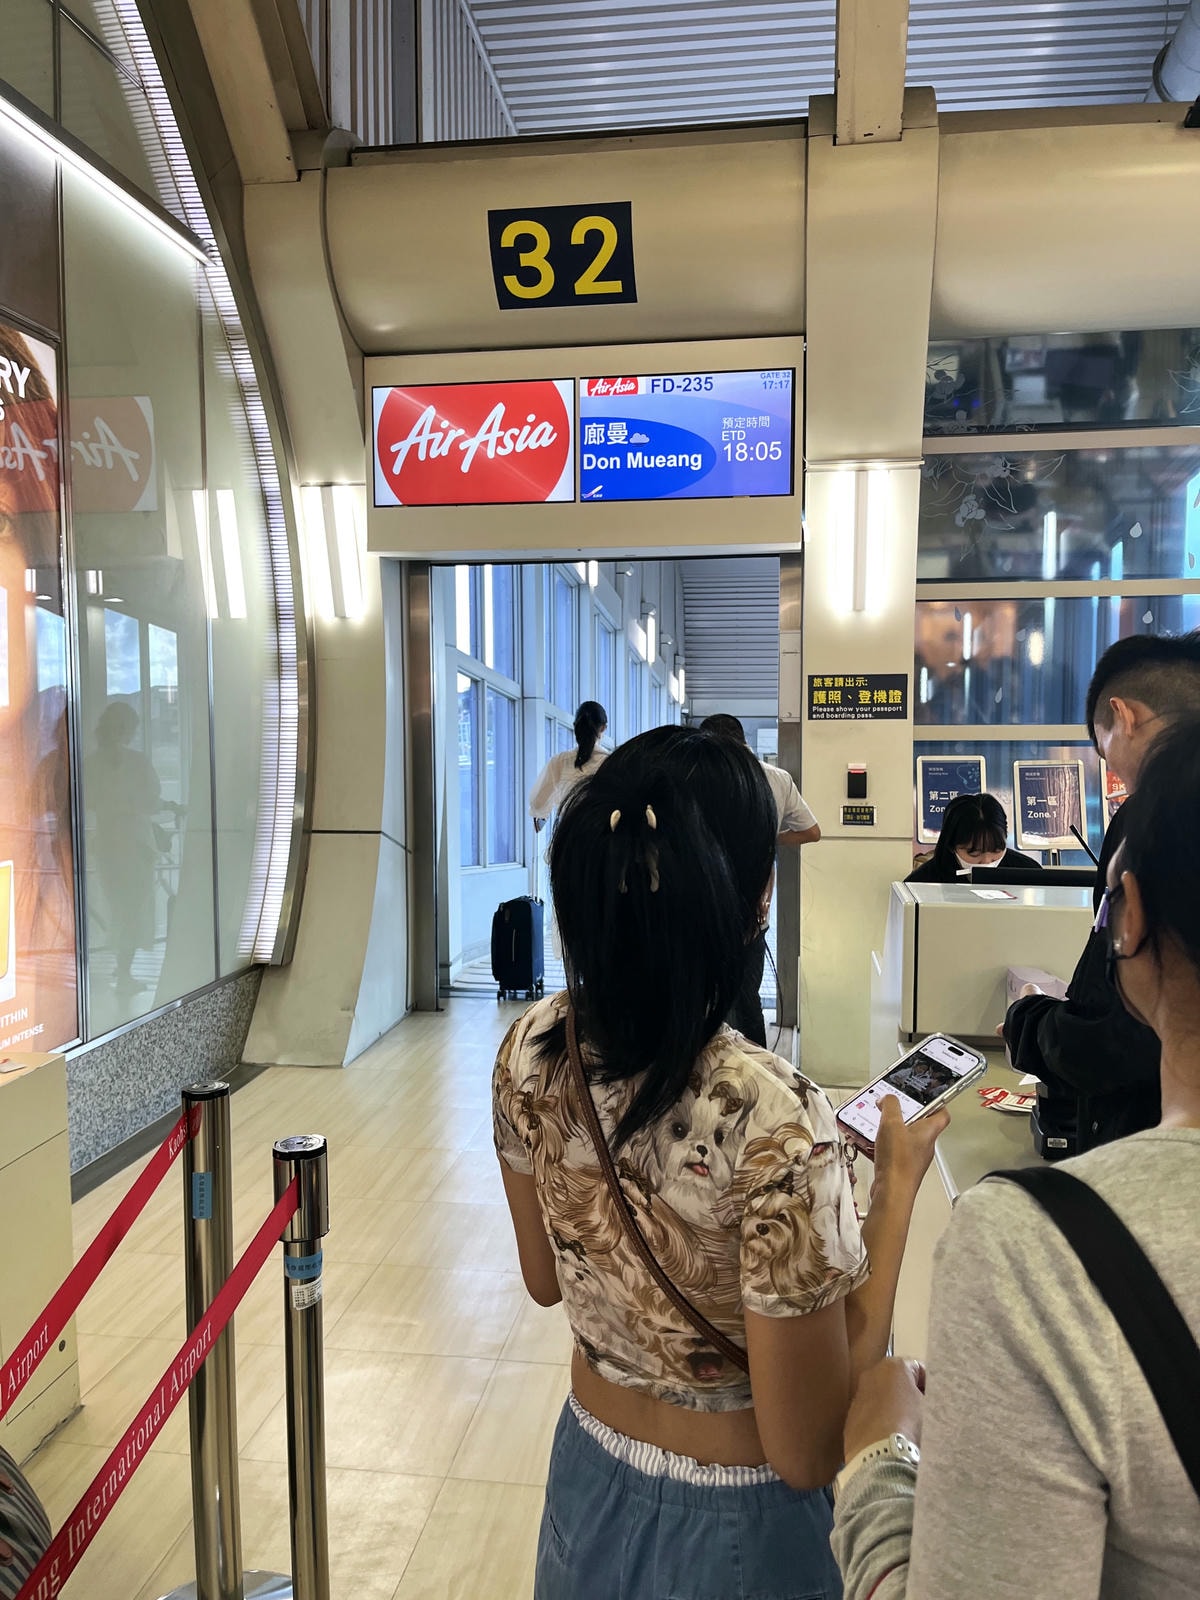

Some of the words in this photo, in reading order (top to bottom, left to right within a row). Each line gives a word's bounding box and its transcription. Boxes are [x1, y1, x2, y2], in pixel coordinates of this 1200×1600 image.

[501, 215, 623, 299] 32
[590, 376, 636, 396] AirAsia
[651, 376, 714, 394] FD-235
[762, 380, 790, 390] 17:17
[722, 416, 770, 429] 預定時間
[389, 401, 558, 475] AirAsia
[583, 421, 629, 446] 廊曼
[721, 430, 746, 441] ETD
[583, 453, 621, 470] Don
[627, 451, 702, 470] Mueang
[723, 441, 782, 462] 18:05
[813, 690, 903, 704] 護照、登機證
[929, 804, 946, 813] Zon
[1027, 810, 1051, 819] Zone
[0, 1007, 28, 1028] ITHIN
[7, 1321, 49, 1401] Airport
[30, 1556, 60, 1600] ng
[68, 1385, 166, 1562] International
[169, 1319, 212, 1402] Airport
